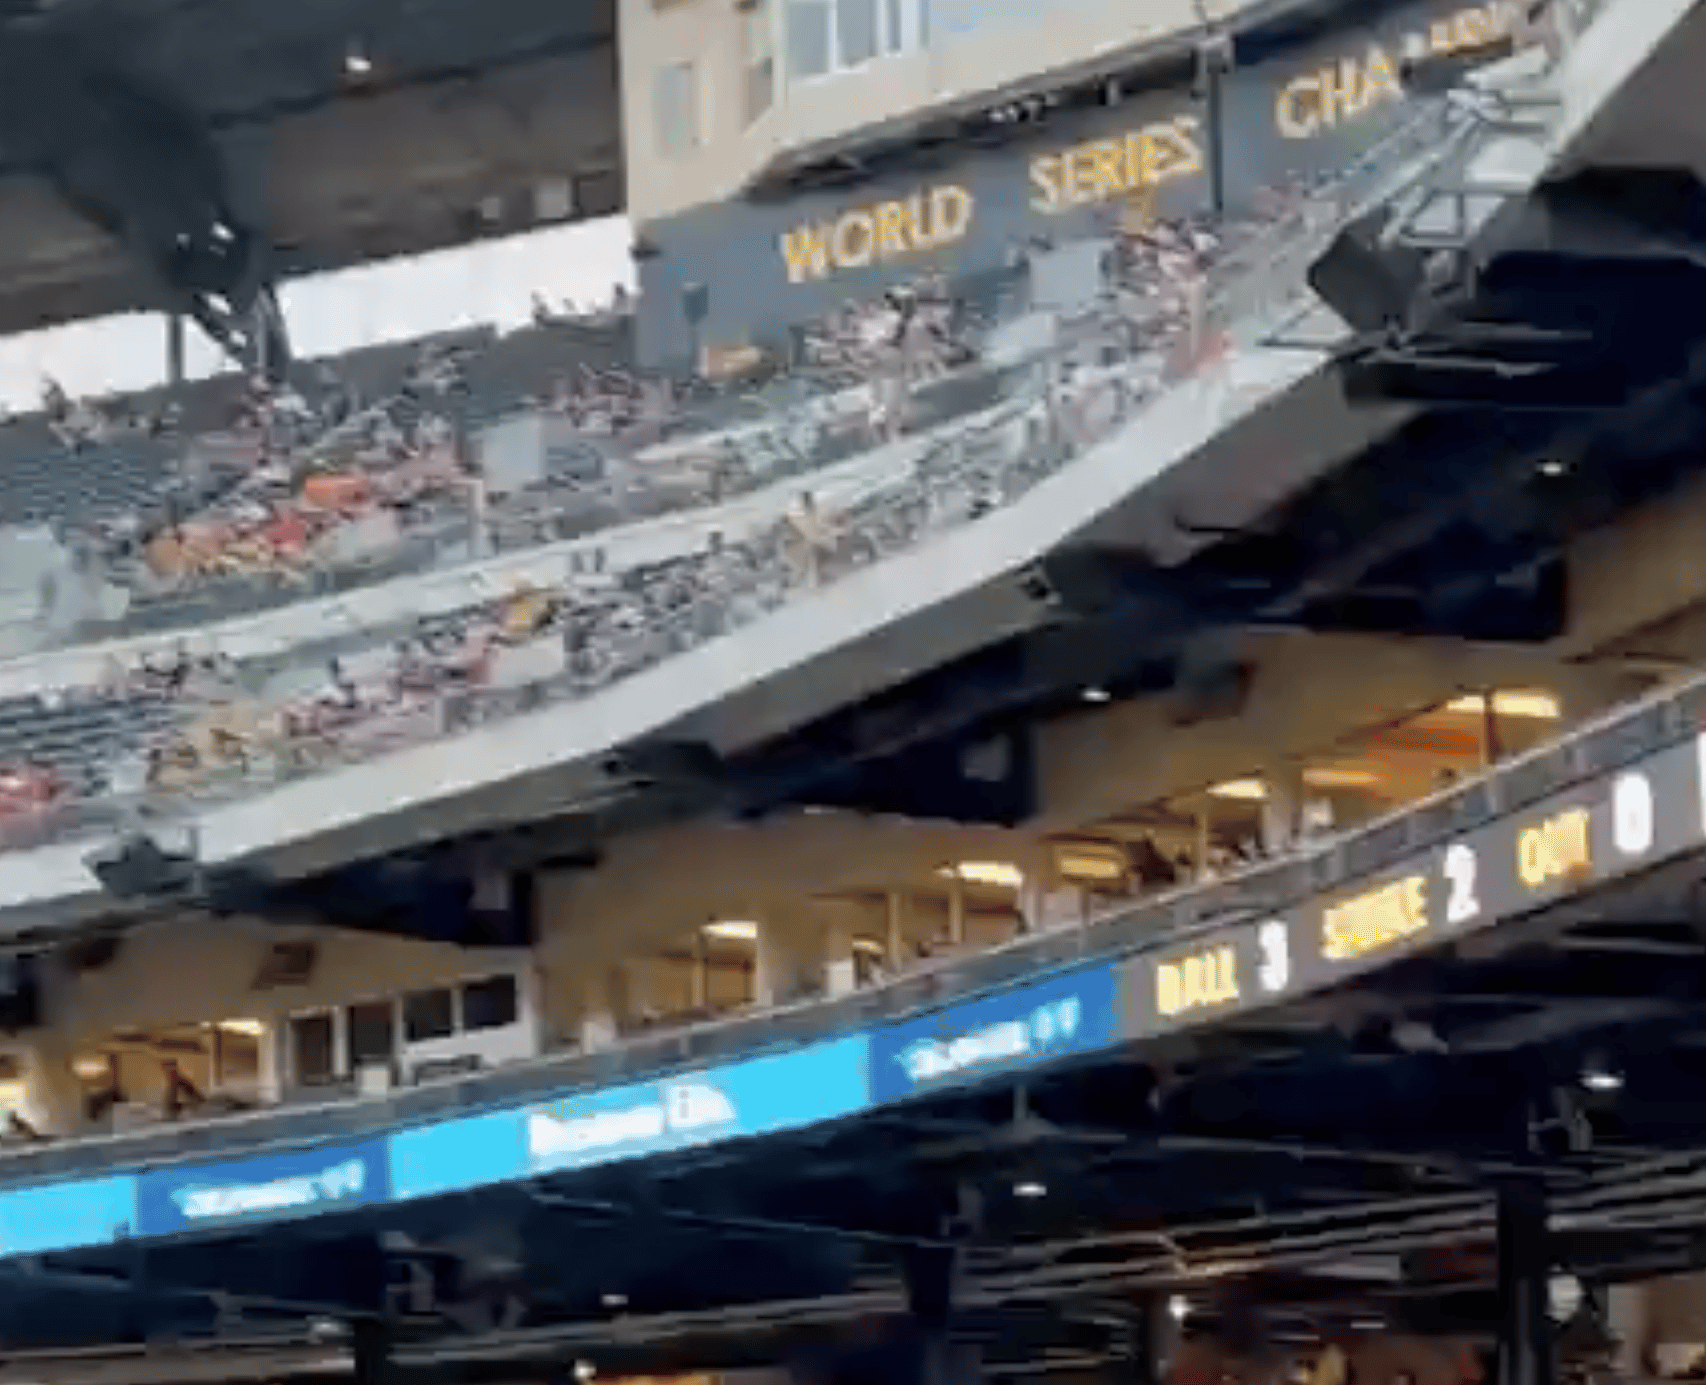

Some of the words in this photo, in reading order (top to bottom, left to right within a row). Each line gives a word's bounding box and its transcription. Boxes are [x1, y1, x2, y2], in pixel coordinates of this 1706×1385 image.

[779, 184, 973, 284] WORLD
[1028, 115, 1203, 215] SERIES
[1443, 842, 1481, 924] 2
